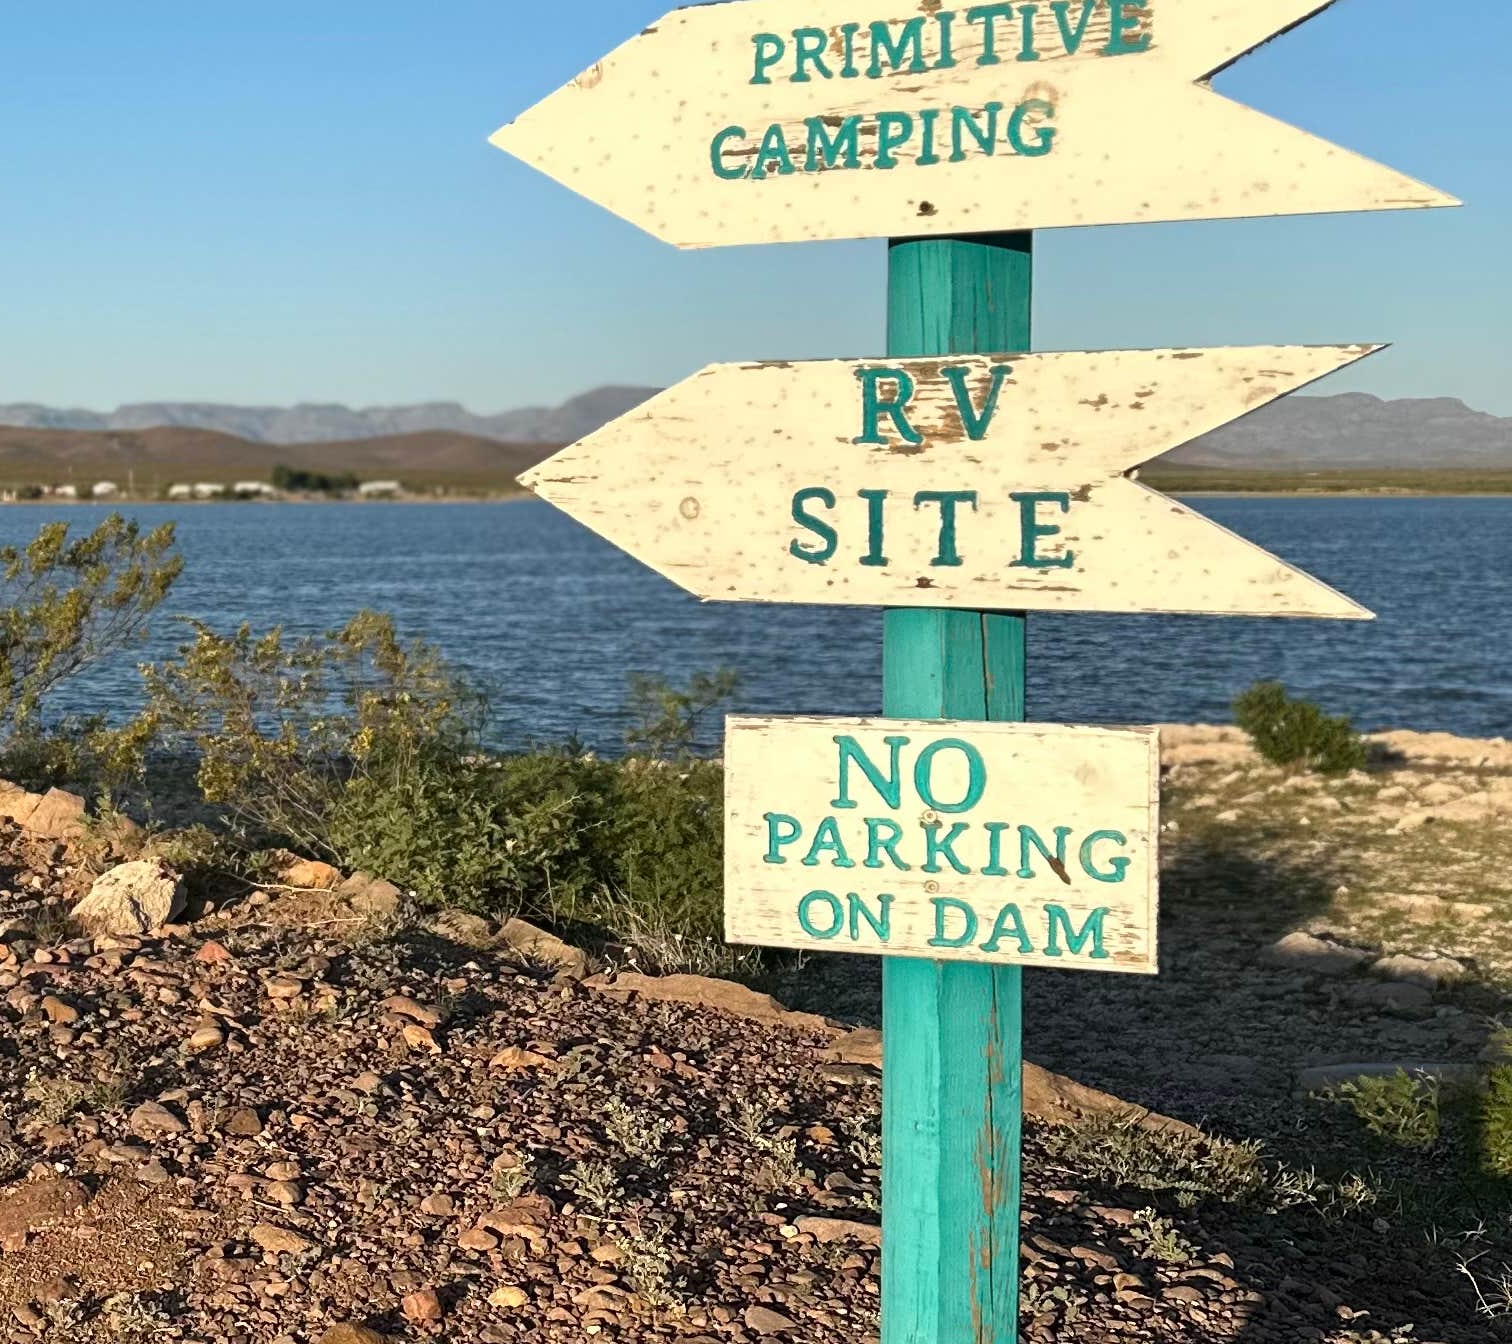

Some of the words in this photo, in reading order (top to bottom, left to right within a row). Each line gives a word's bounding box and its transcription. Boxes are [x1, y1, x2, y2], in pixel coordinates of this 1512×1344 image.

[710, 98, 1056, 180] CAMPING
[853, 364, 1013, 446] RV
[789, 486, 1074, 568] SITE
[830, 734, 988, 814] NO
[762, 811, 1131, 885] PARKING
[797, 889, 895, 942] ON
[926, 896, 1112, 958] DAM
